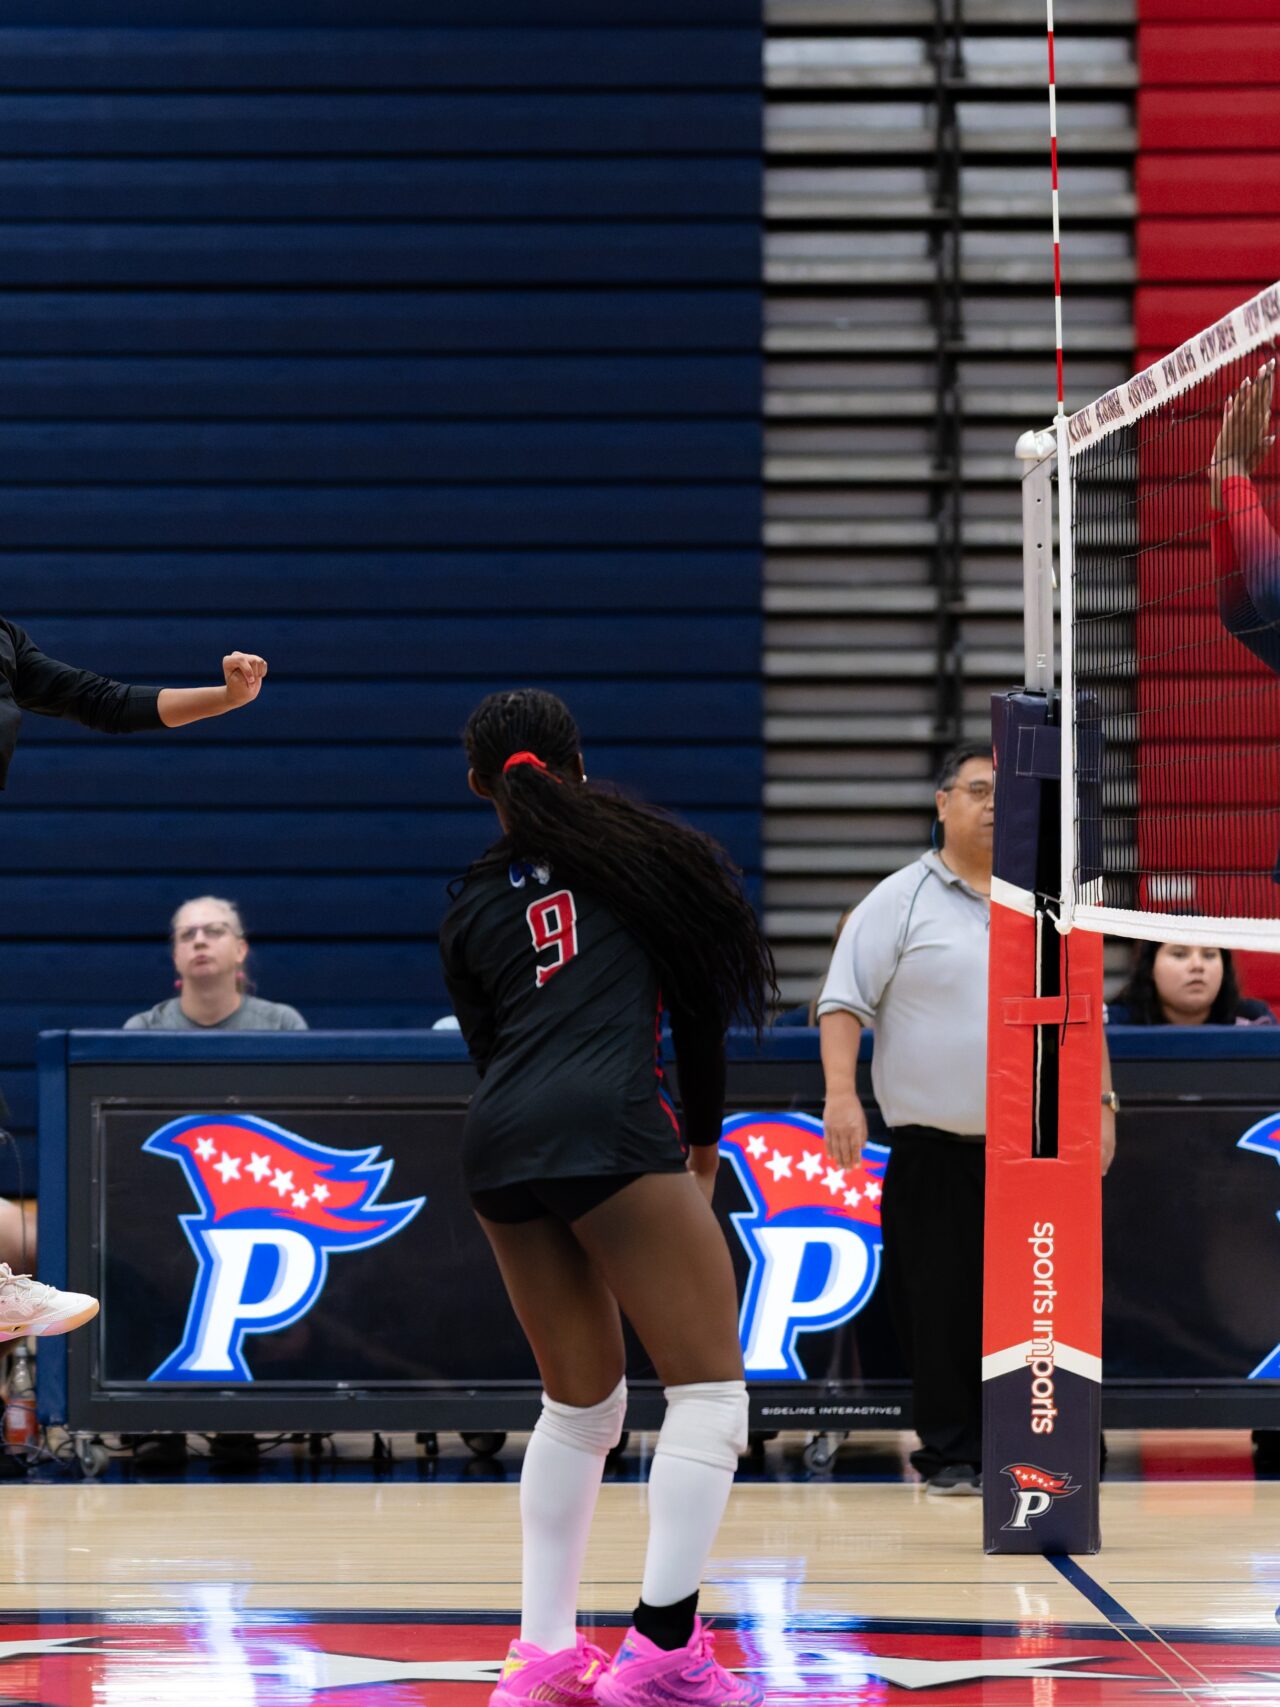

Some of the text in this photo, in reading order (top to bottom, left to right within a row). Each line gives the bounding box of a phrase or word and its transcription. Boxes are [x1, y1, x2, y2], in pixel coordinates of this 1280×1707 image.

[526, 889, 578, 987] 9
[178, 1229, 316, 1371] P
[744, 1227, 868, 1370] P
[1026, 1222, 1058, 1434] sports imports
[761, 1407, 902, 1415] SIDELINE INTERACTIVES
[1010, 1491, 1050, 1527] P
